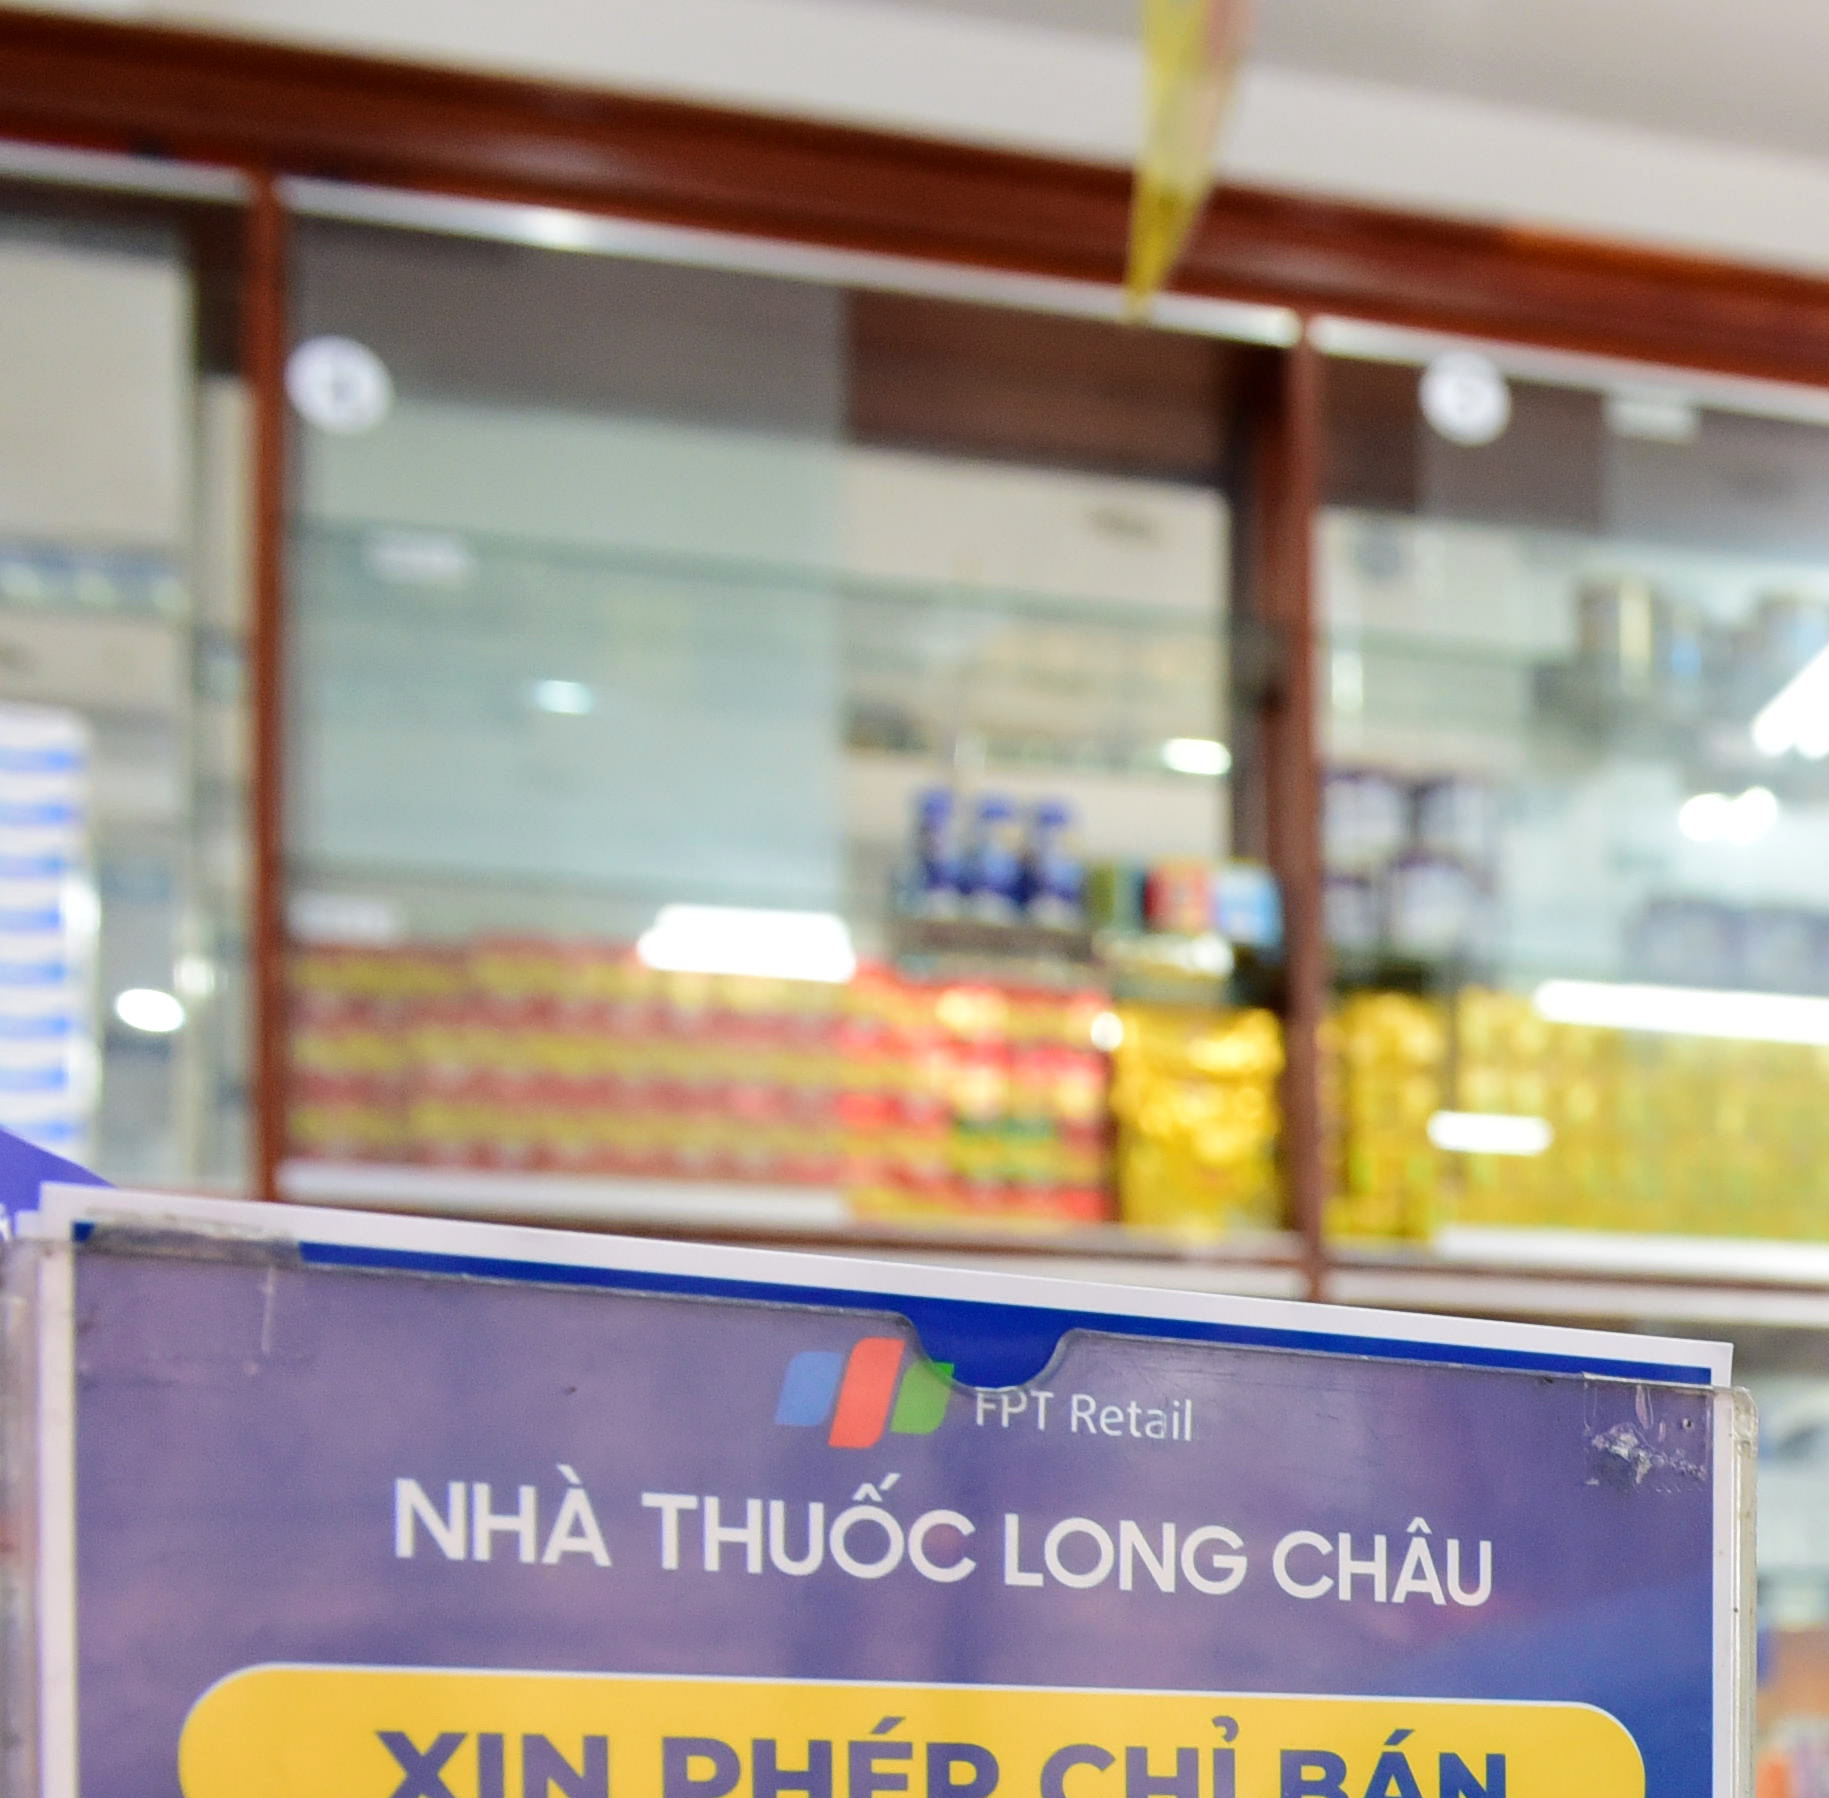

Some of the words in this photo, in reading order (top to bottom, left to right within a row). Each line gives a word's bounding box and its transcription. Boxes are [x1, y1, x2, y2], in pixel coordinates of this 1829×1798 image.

[974, 1389, 1055, 1431] FPT
[1071, 1394, 1192, 1441] Retail
[396, 1465, 611, 1567] NHÀ
[641, 1473, 976, 1582] THUỐC
[1005, 1514, 1247, 1594] LONG
[1272, 1517, 1491, 1606] CHÂU
